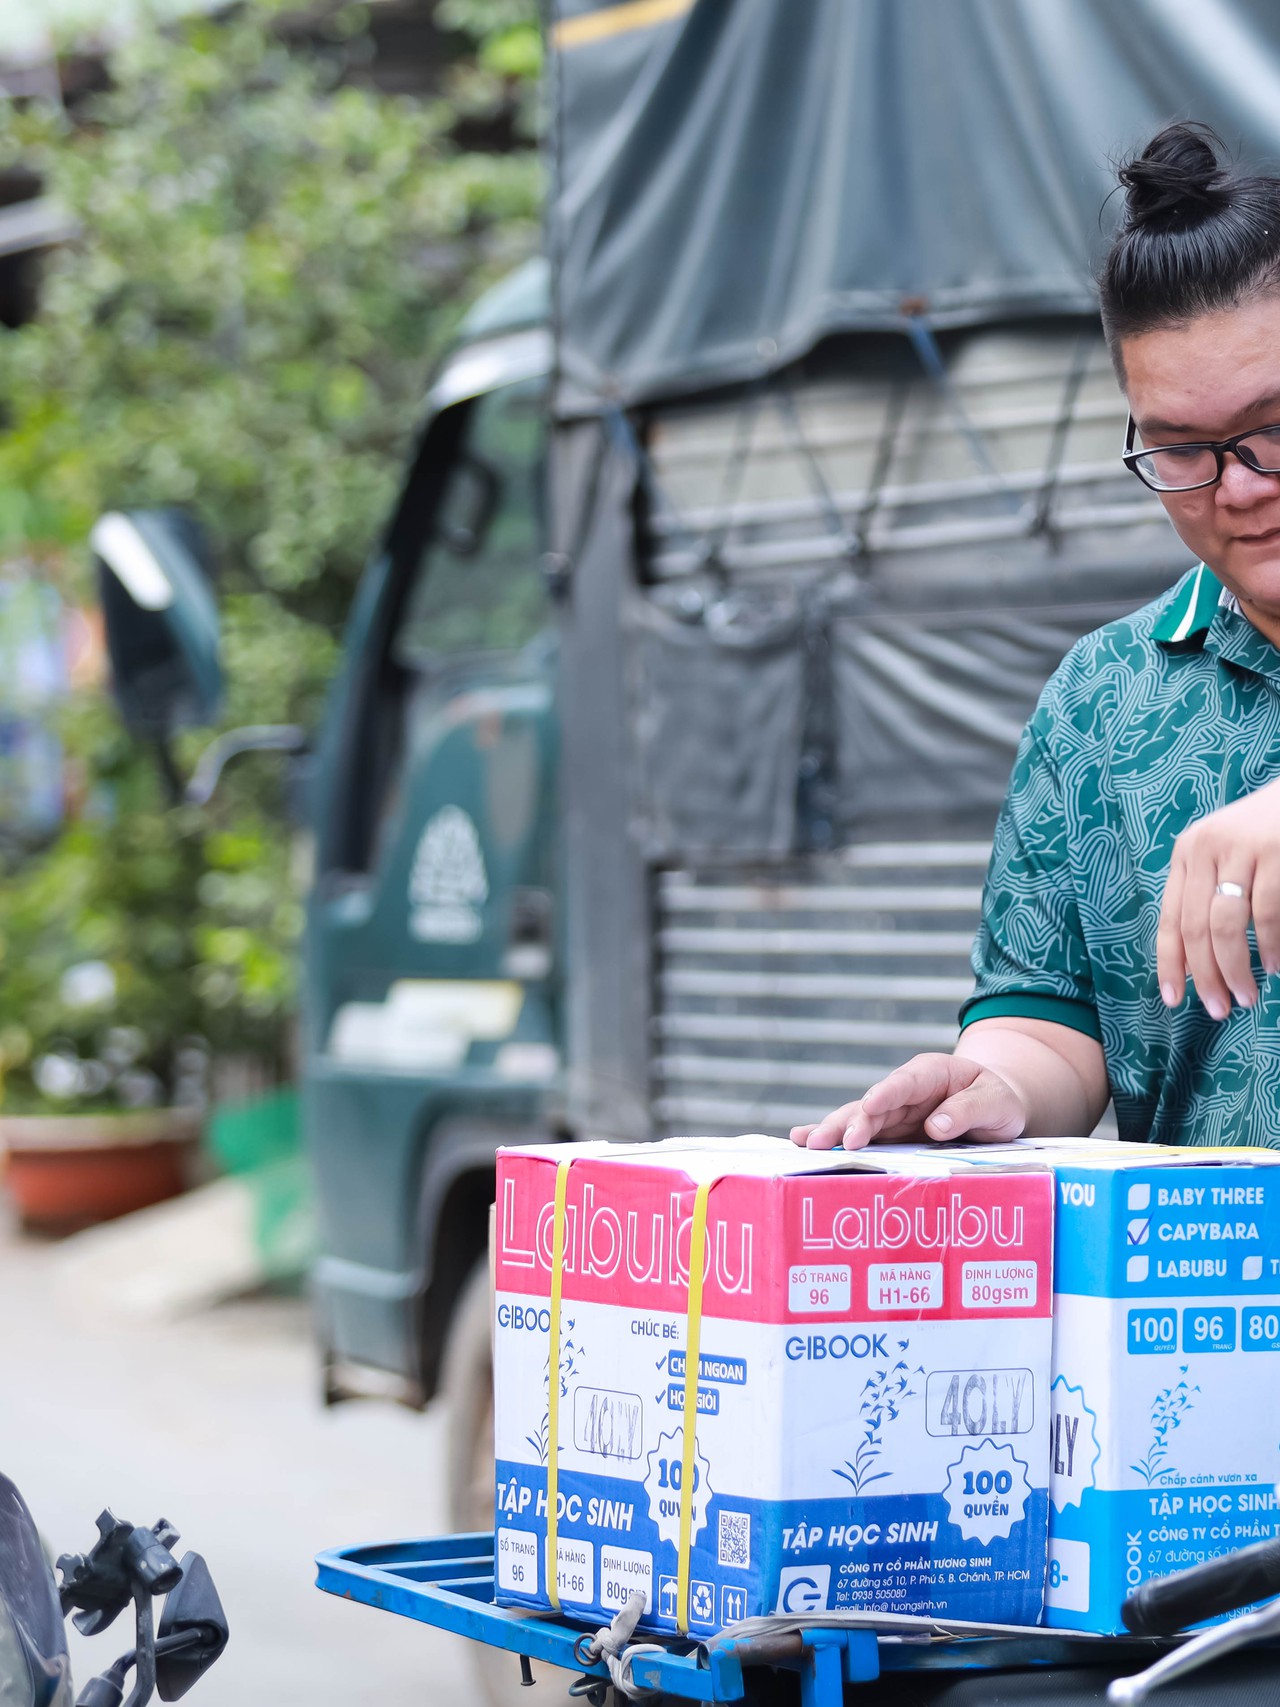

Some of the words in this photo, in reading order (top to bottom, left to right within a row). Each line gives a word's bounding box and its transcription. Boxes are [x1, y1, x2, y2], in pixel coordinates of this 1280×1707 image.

[1060, 1182, 1095, 1207] YOU
[1157, 1187, 1206, 1206] BABY
[1211, 1187, 1265, 1205] THREE
[802, 1194, 1024, 1250] Labubu
[1158, 1222, 1259, 1241] CAPYBARA
[502, 1178, 753, 1294] Labubu
[792, 1270, 807, 1284] SỐ
[811, 1271, 848, 1283] TRANG
[880, 1269, 897, 1282] MÃ
[900, 1268, 931, 1282] HÀNG
[965, 1268, 992, 1281] ĐỊNH
[995, 1266, 1034, 1281] LƯỢNG
[1157, 1259, 1227, 1278] LABUBU
[809, 1288, 829, 1305] 96
[879, 1286, 931, 1304] H1-66
[971, 1284, 1029, 1305] 80gsm
[498, 1304, 562, 1335] GIBOO
[631, 1319, 660, 1338] CHÚC
[663, 1321, 680, 1340] BÉ:
[1131, 1316, 1174, 1343] 100
[1194, 1315, 1224, 1342] 96
[1249, 1314, 1279, 1340] 80
[785, 1333, 890, 1361] GIBOOK
[704, 1361, 743, 1381] NGOAN
[696, 1389, 716, 1411] GIỎI
[1050, 1413, 1079, 1477] LY
[963, 1470, 1012, 1496] 100
[1190, 1473, 1215, 1484] cánh
[1245, 1473, 1257, 1482] xa
[497, 1477, 532, 1521] TẬP
[586, 1495, 634, 1532] SINH
[963, 1496, 1010, 1517] QUYỂN
[1149, 1492, 1184, 1521] TẬP
[1189, 1495, 1232, 1519] HỌC
[1238, 1493, 1280, 1511] SINH
[782, 1522, 824, 1554] TẬP
[828, 1524, 884, 1551] HỌC
[886, 1520, 939, 1543] SINH
[1148, 1525, 1188, 1542] CÔNG
[1192, 1527, 1206, 1539] TY
[1210, 1519, 1231, 1539] CỔ
[1234, 1518, 1270, 1538] PHẦN
[500, 1536, 510, 1552] SỐ
[511, 1540, 536, 1556] TRANG
[1148, 1550, 1162, 1564] 67
[1165, 1548, 1205, 1564] đường
[565, 1549, 586, 1564] HÀNG
[603, 1557, 621, 1572] ĐỊNH
[839, 1562, 870, 1574] CÔNG
[873, 1562, 884, 1572] TY
[886, 1557, 902, 1571] CỔ
[904, 1556, 931, 1570] PHẦN
[934, 1557, 967, 1569] TƯƠNG
[969, 1557, 992, 1568] SINH
[512, 1565, 525, 1583] 96
[837, 1578, 848, 1589] 67
[850, 1578, 881, 1590] đường
[882, 1575, 893, 1587] số
[896, 1575, 907, 1587] 10,
[910, 1576, 917, 1585] P.
[919, 1574, 936, 1585] Phú
[938, 1574, 946, 1584] 5,
[949, 1573, 956, 1583] B.
[994, 1571, 1005, 1581] TP.
[1007, 1570, 1030, 1580] HCM
[836, 1591, 850, 1602] Tel:
[852, 1591, 873, 1601] 0938
[875, 1589, 907, 1599] 505080
[891, 1600, 948, 1612] tuongsinh.vn
